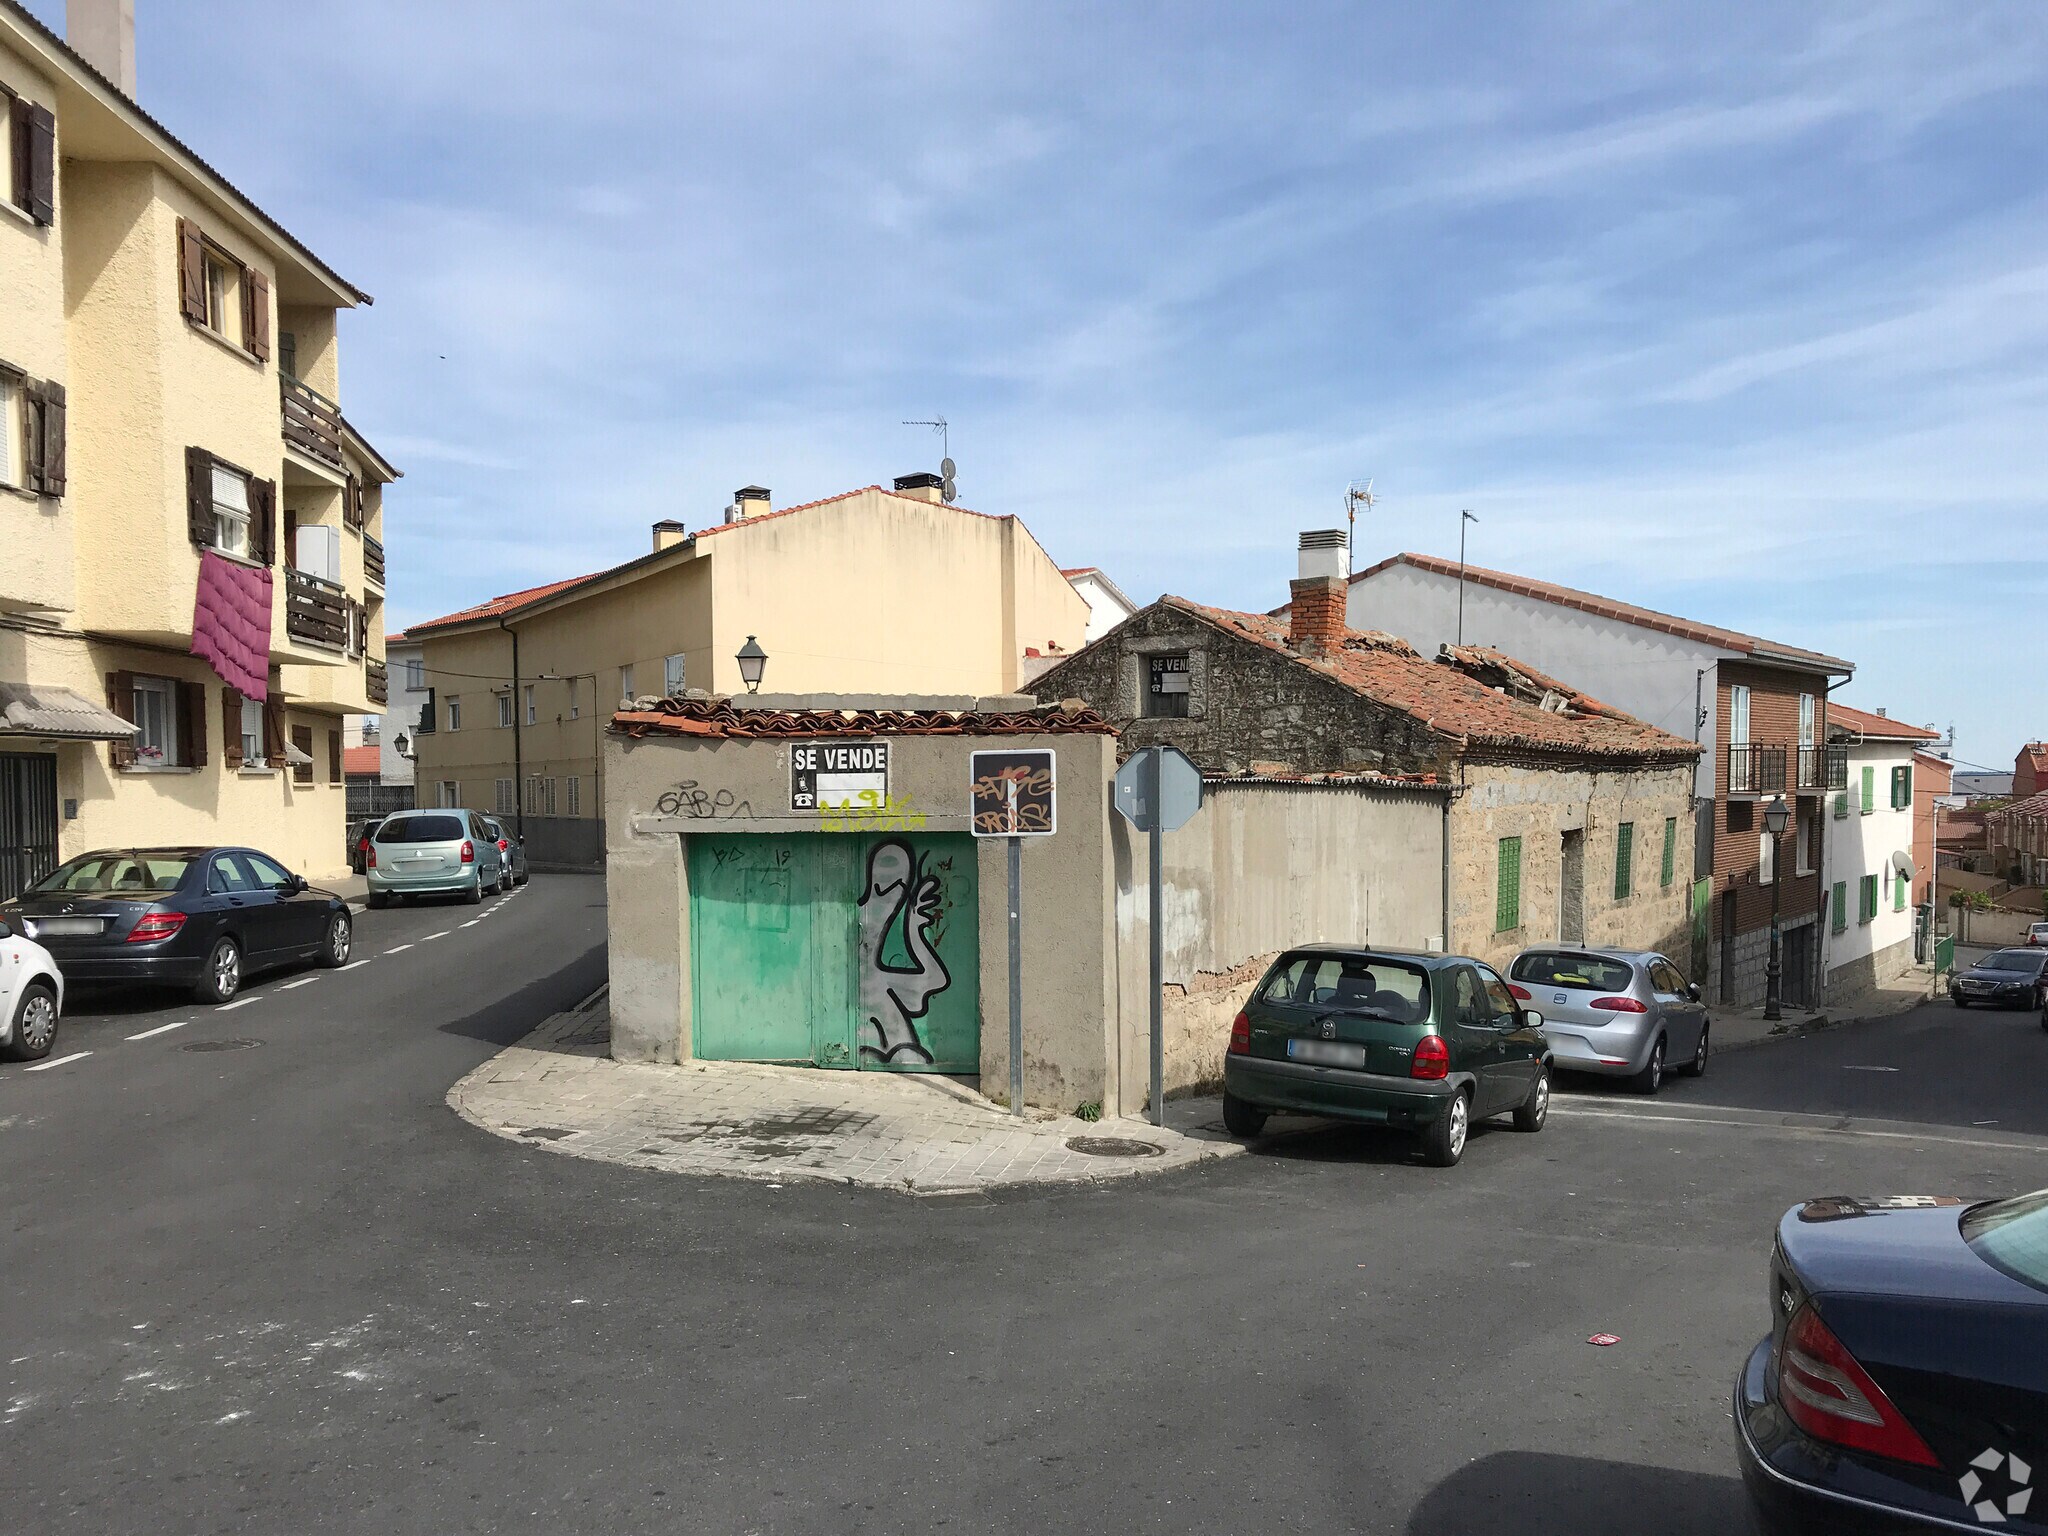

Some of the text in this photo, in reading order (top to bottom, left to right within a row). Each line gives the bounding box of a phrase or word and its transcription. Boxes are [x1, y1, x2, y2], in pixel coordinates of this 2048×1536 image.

[1152, 659, 1163, 671] SE
[795, 748, 885, 770] SE VENDE
